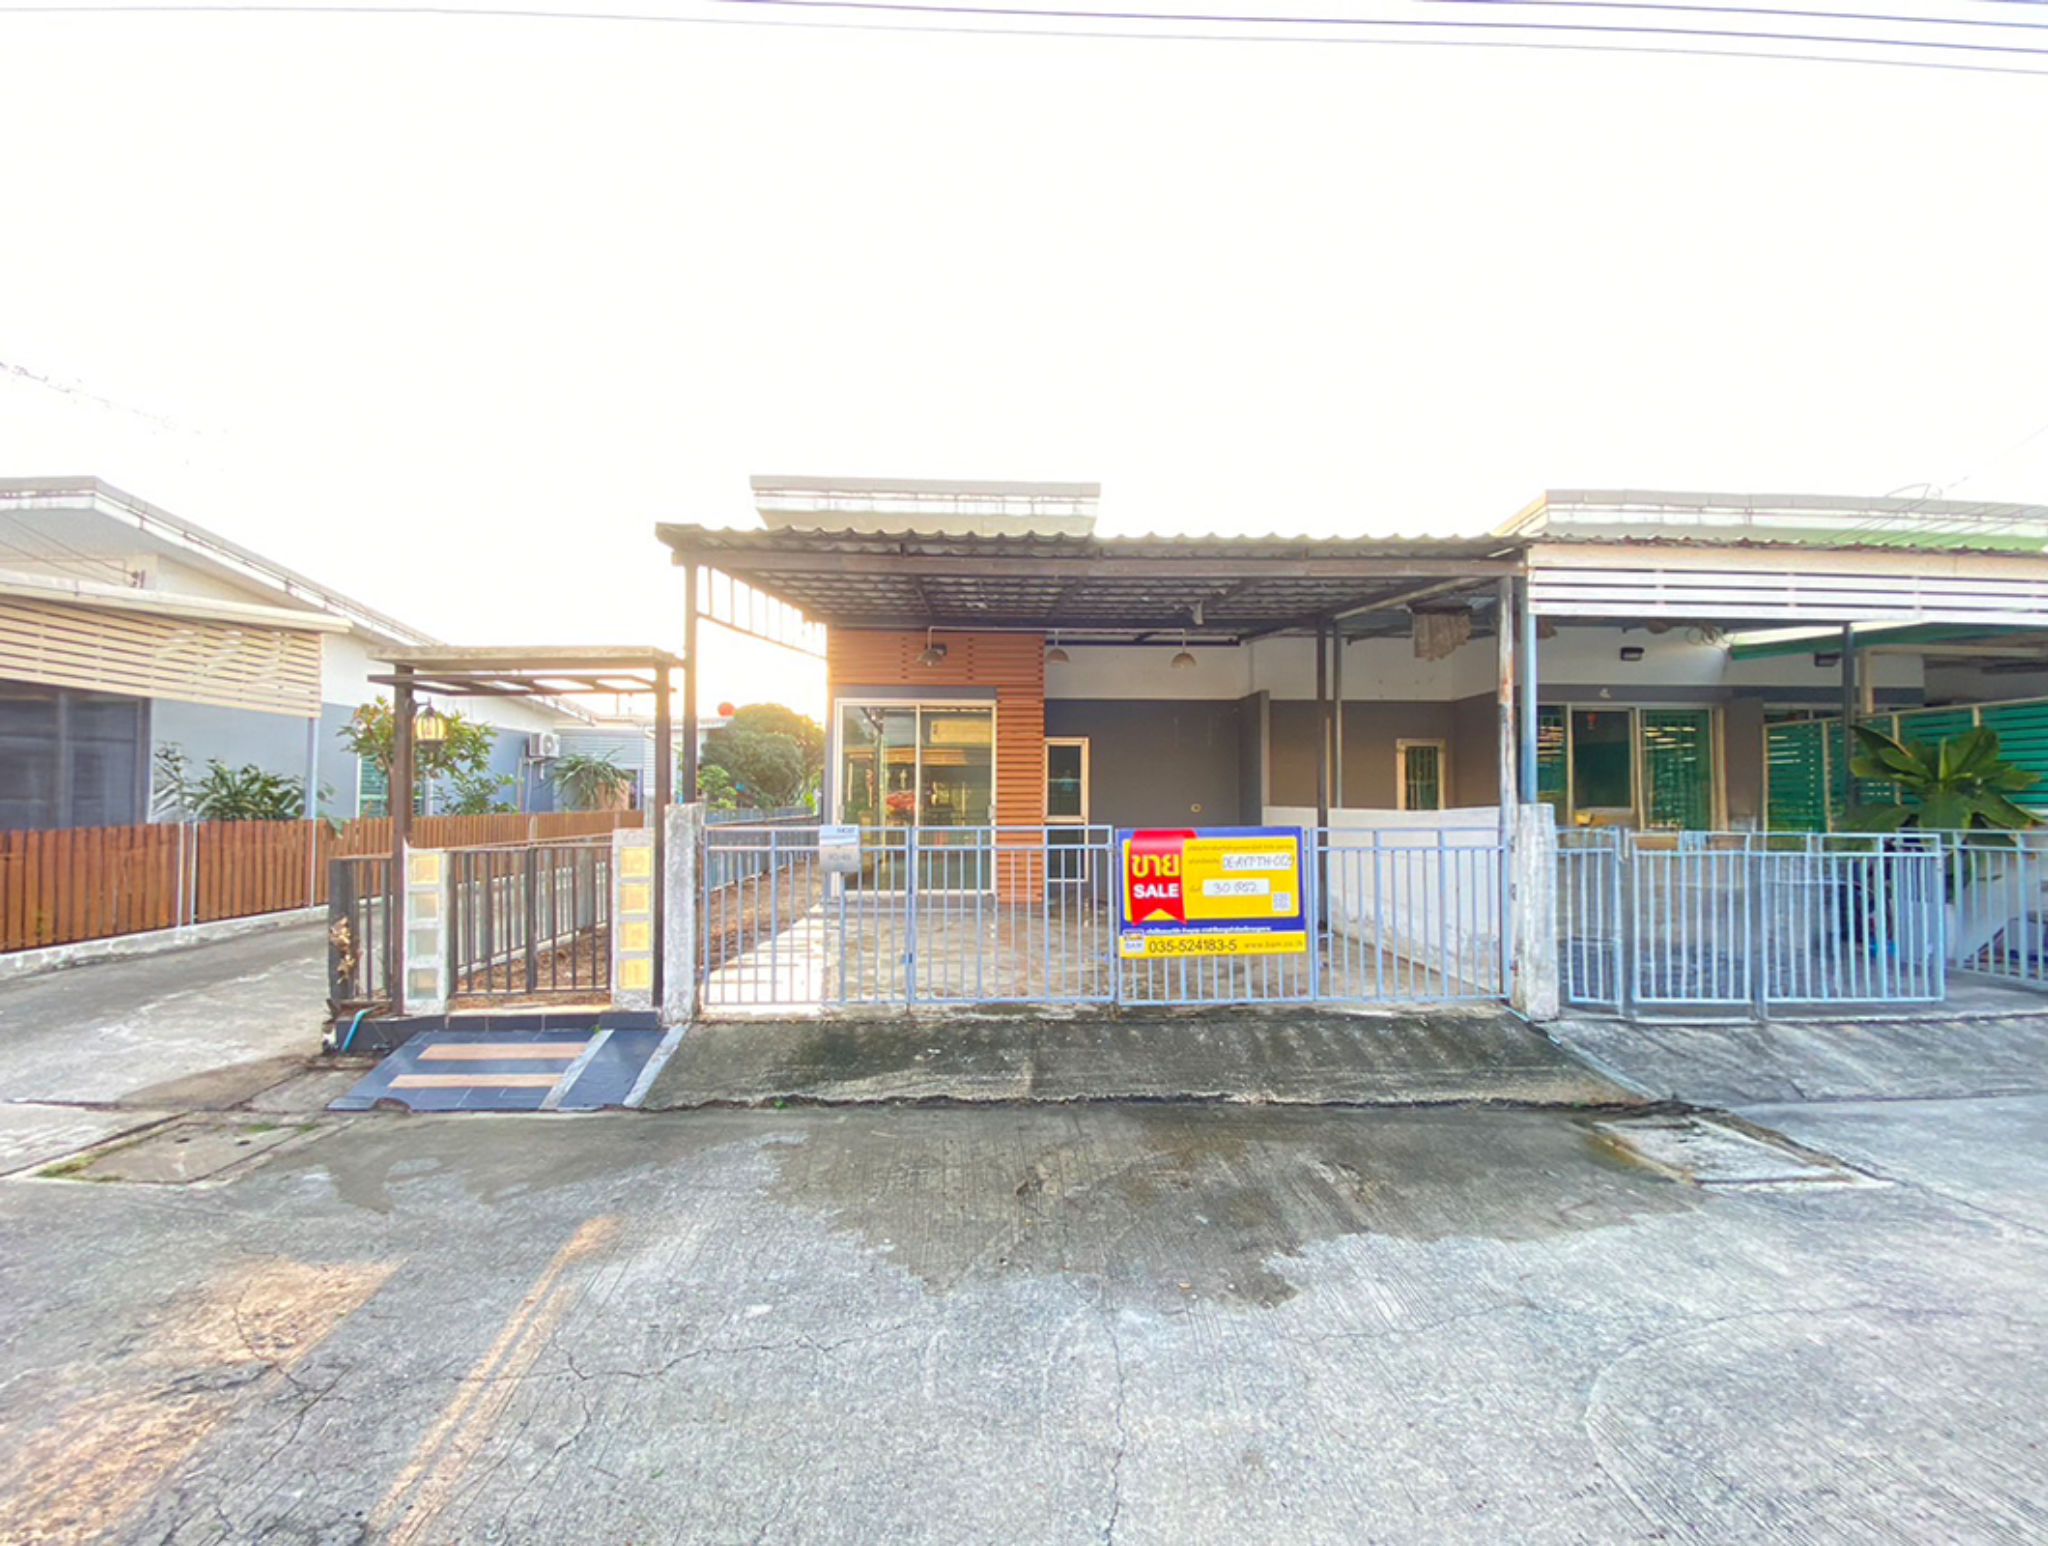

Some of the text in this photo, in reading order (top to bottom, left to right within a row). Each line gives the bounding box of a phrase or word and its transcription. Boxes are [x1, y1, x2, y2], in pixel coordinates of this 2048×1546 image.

[1131, 854, 1180, 877] ขาย
[1134, 883, 1179, 898] SALE
[1149, 939, 1237, 953] 035-524183-5
